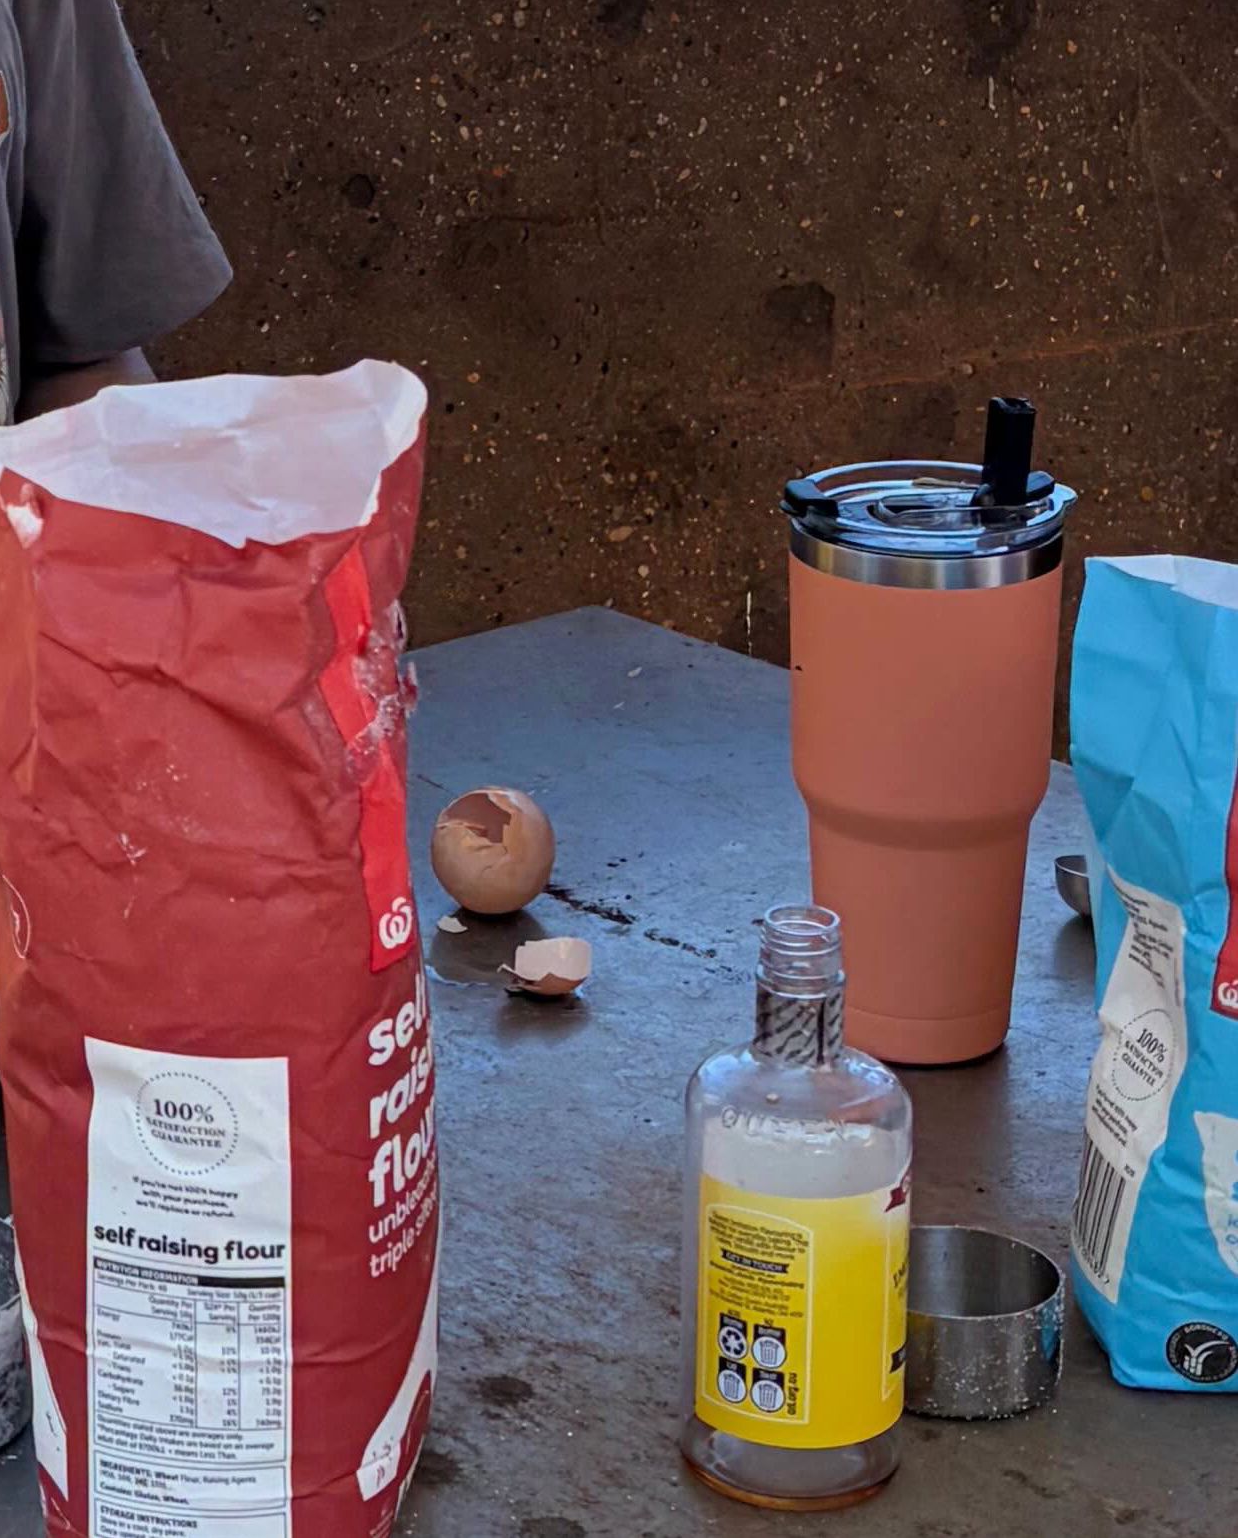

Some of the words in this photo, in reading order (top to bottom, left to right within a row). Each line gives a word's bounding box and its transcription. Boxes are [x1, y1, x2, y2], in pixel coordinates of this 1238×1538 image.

[1137, 1027, 1166, 1064] 100%
[154, 1098, 215, 1123] 100%
[146, 1117, 226, 1137] SATISFACTION
[151, 1129, 222, 1148] GUARANTEE
[94, 1225, 135, 1246] self
[139, 1235, 219, 1264] raising
[224, 1241, 286, 1260] flour
[369, 1222, 415, 1278] triple
[141, 1266, 198, 1284] INFORMATION
[149, 1295, 179, 1308] Quantity
[181, 1299, 193, 1308] Per
[249, 1304, 280, 1313] Quantity
[97, 1308, 120, 1321] Energy
[139, 1432, 157, 1443] Daily
[200, 1440, 221, 1449] based
[191, 1432, 224, 1440] averages
[200, 1451, 216, 1459] Less
[155, 1470, 179, 1480] Wheat
[203, 1476, 229, 1485] Raising
[232, 1475, 256, 1484] Agents
[100, 1505, 136, 1522] STORAGE
[137, 1512, 198, 1528] INSTRUCTIONS
